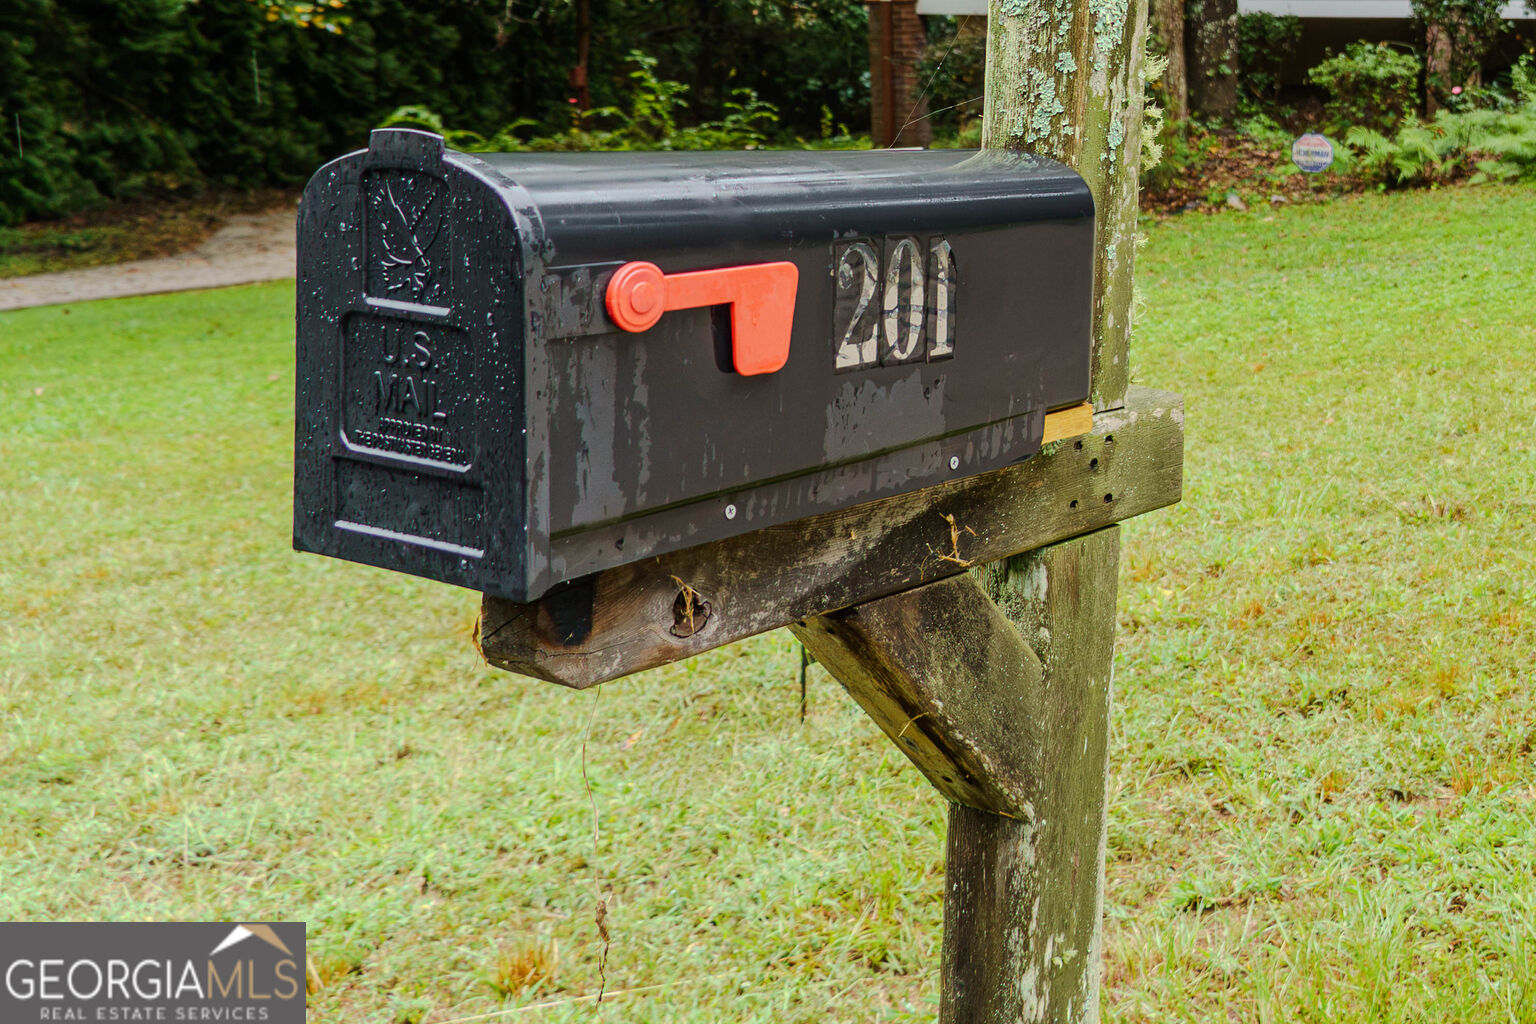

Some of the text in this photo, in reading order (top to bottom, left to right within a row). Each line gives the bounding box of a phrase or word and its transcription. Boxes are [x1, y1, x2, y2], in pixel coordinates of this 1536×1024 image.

[836, 239, 953, 368] 201
[381, 325, 439, 369] U.S.
[373, 370, 447, 417] MAIL
[380, 416, 428, 439] APPROVED
